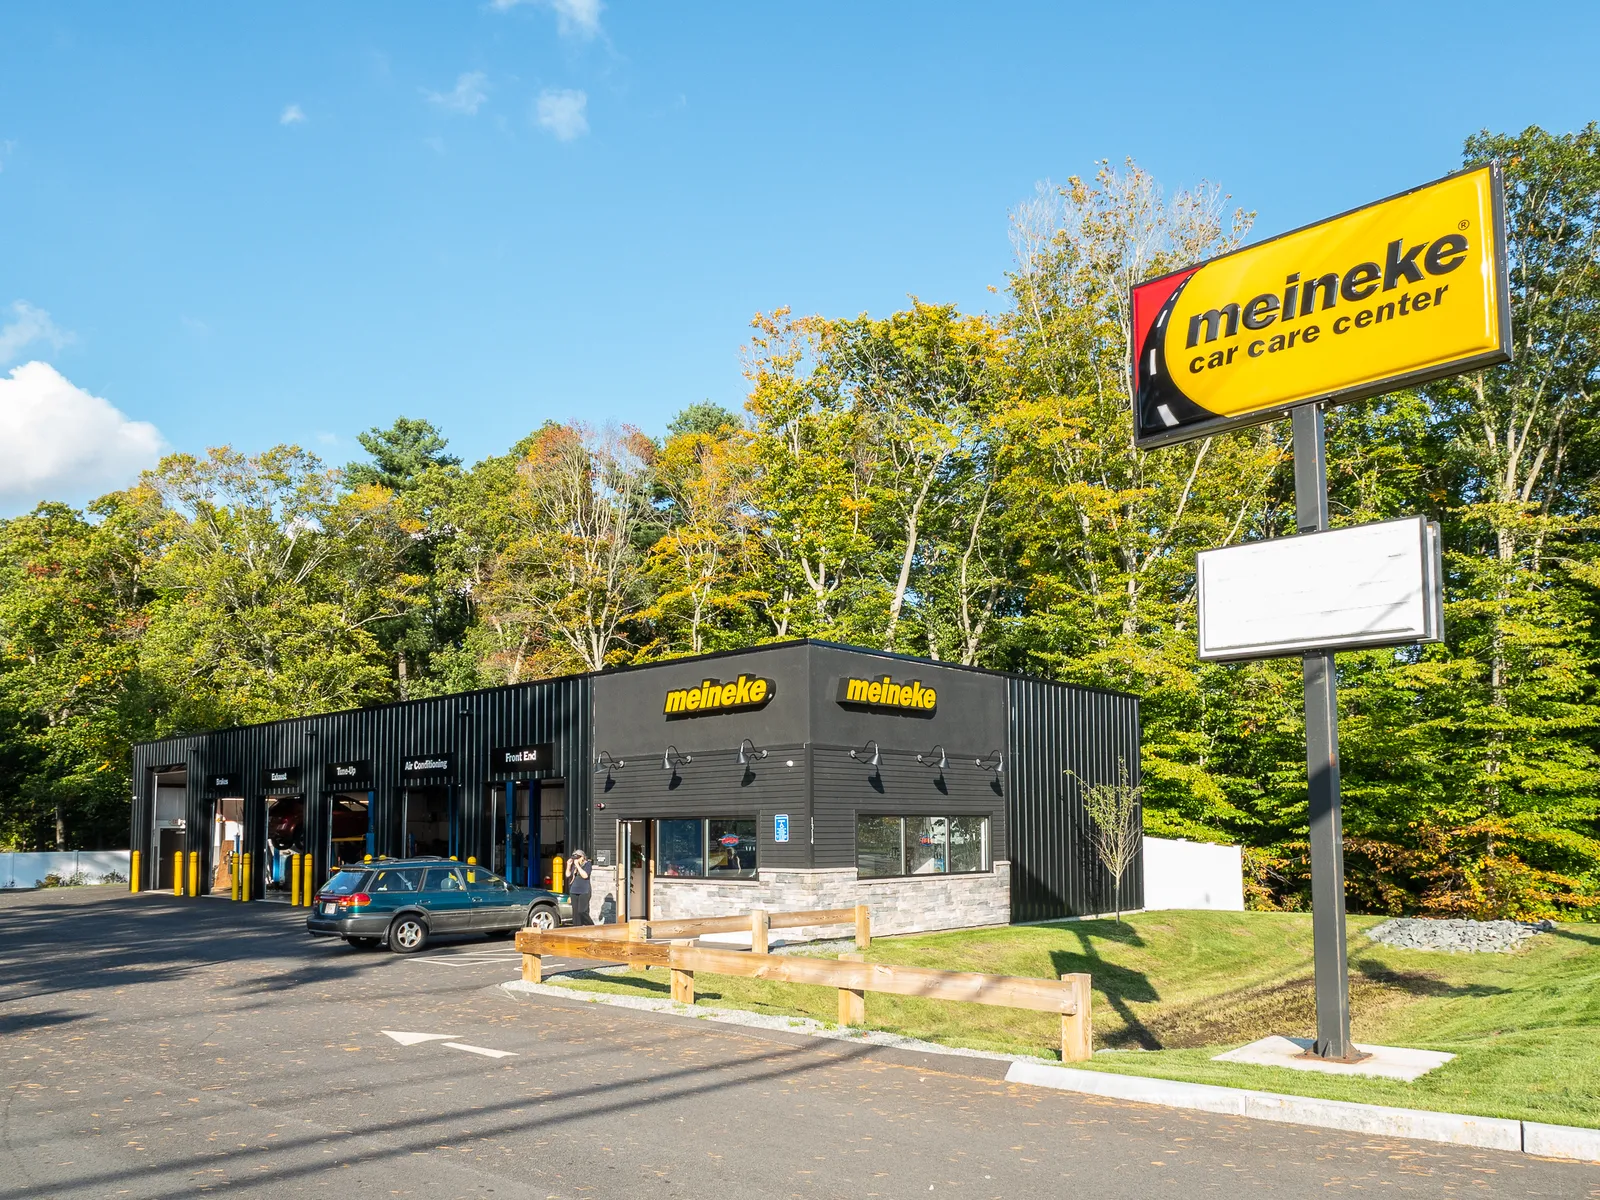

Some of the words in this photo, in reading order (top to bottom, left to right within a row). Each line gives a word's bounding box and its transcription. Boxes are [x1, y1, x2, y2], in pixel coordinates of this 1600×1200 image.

[1185, 233, 1469, 350] meineke
[1189, 344, 1239, 375] car
[1247, 324, 1321, 359] care
[1332, 284, 1449, 336] center
[664, 675, 768, 713] meineke
[846, 677, 937, 710] meineke
[404, 761, 413, 771] Air
[413, 758, 448, 770] Conditioning
[505, 751, 523, 763] Front
[523, 749, 537, 761] End
